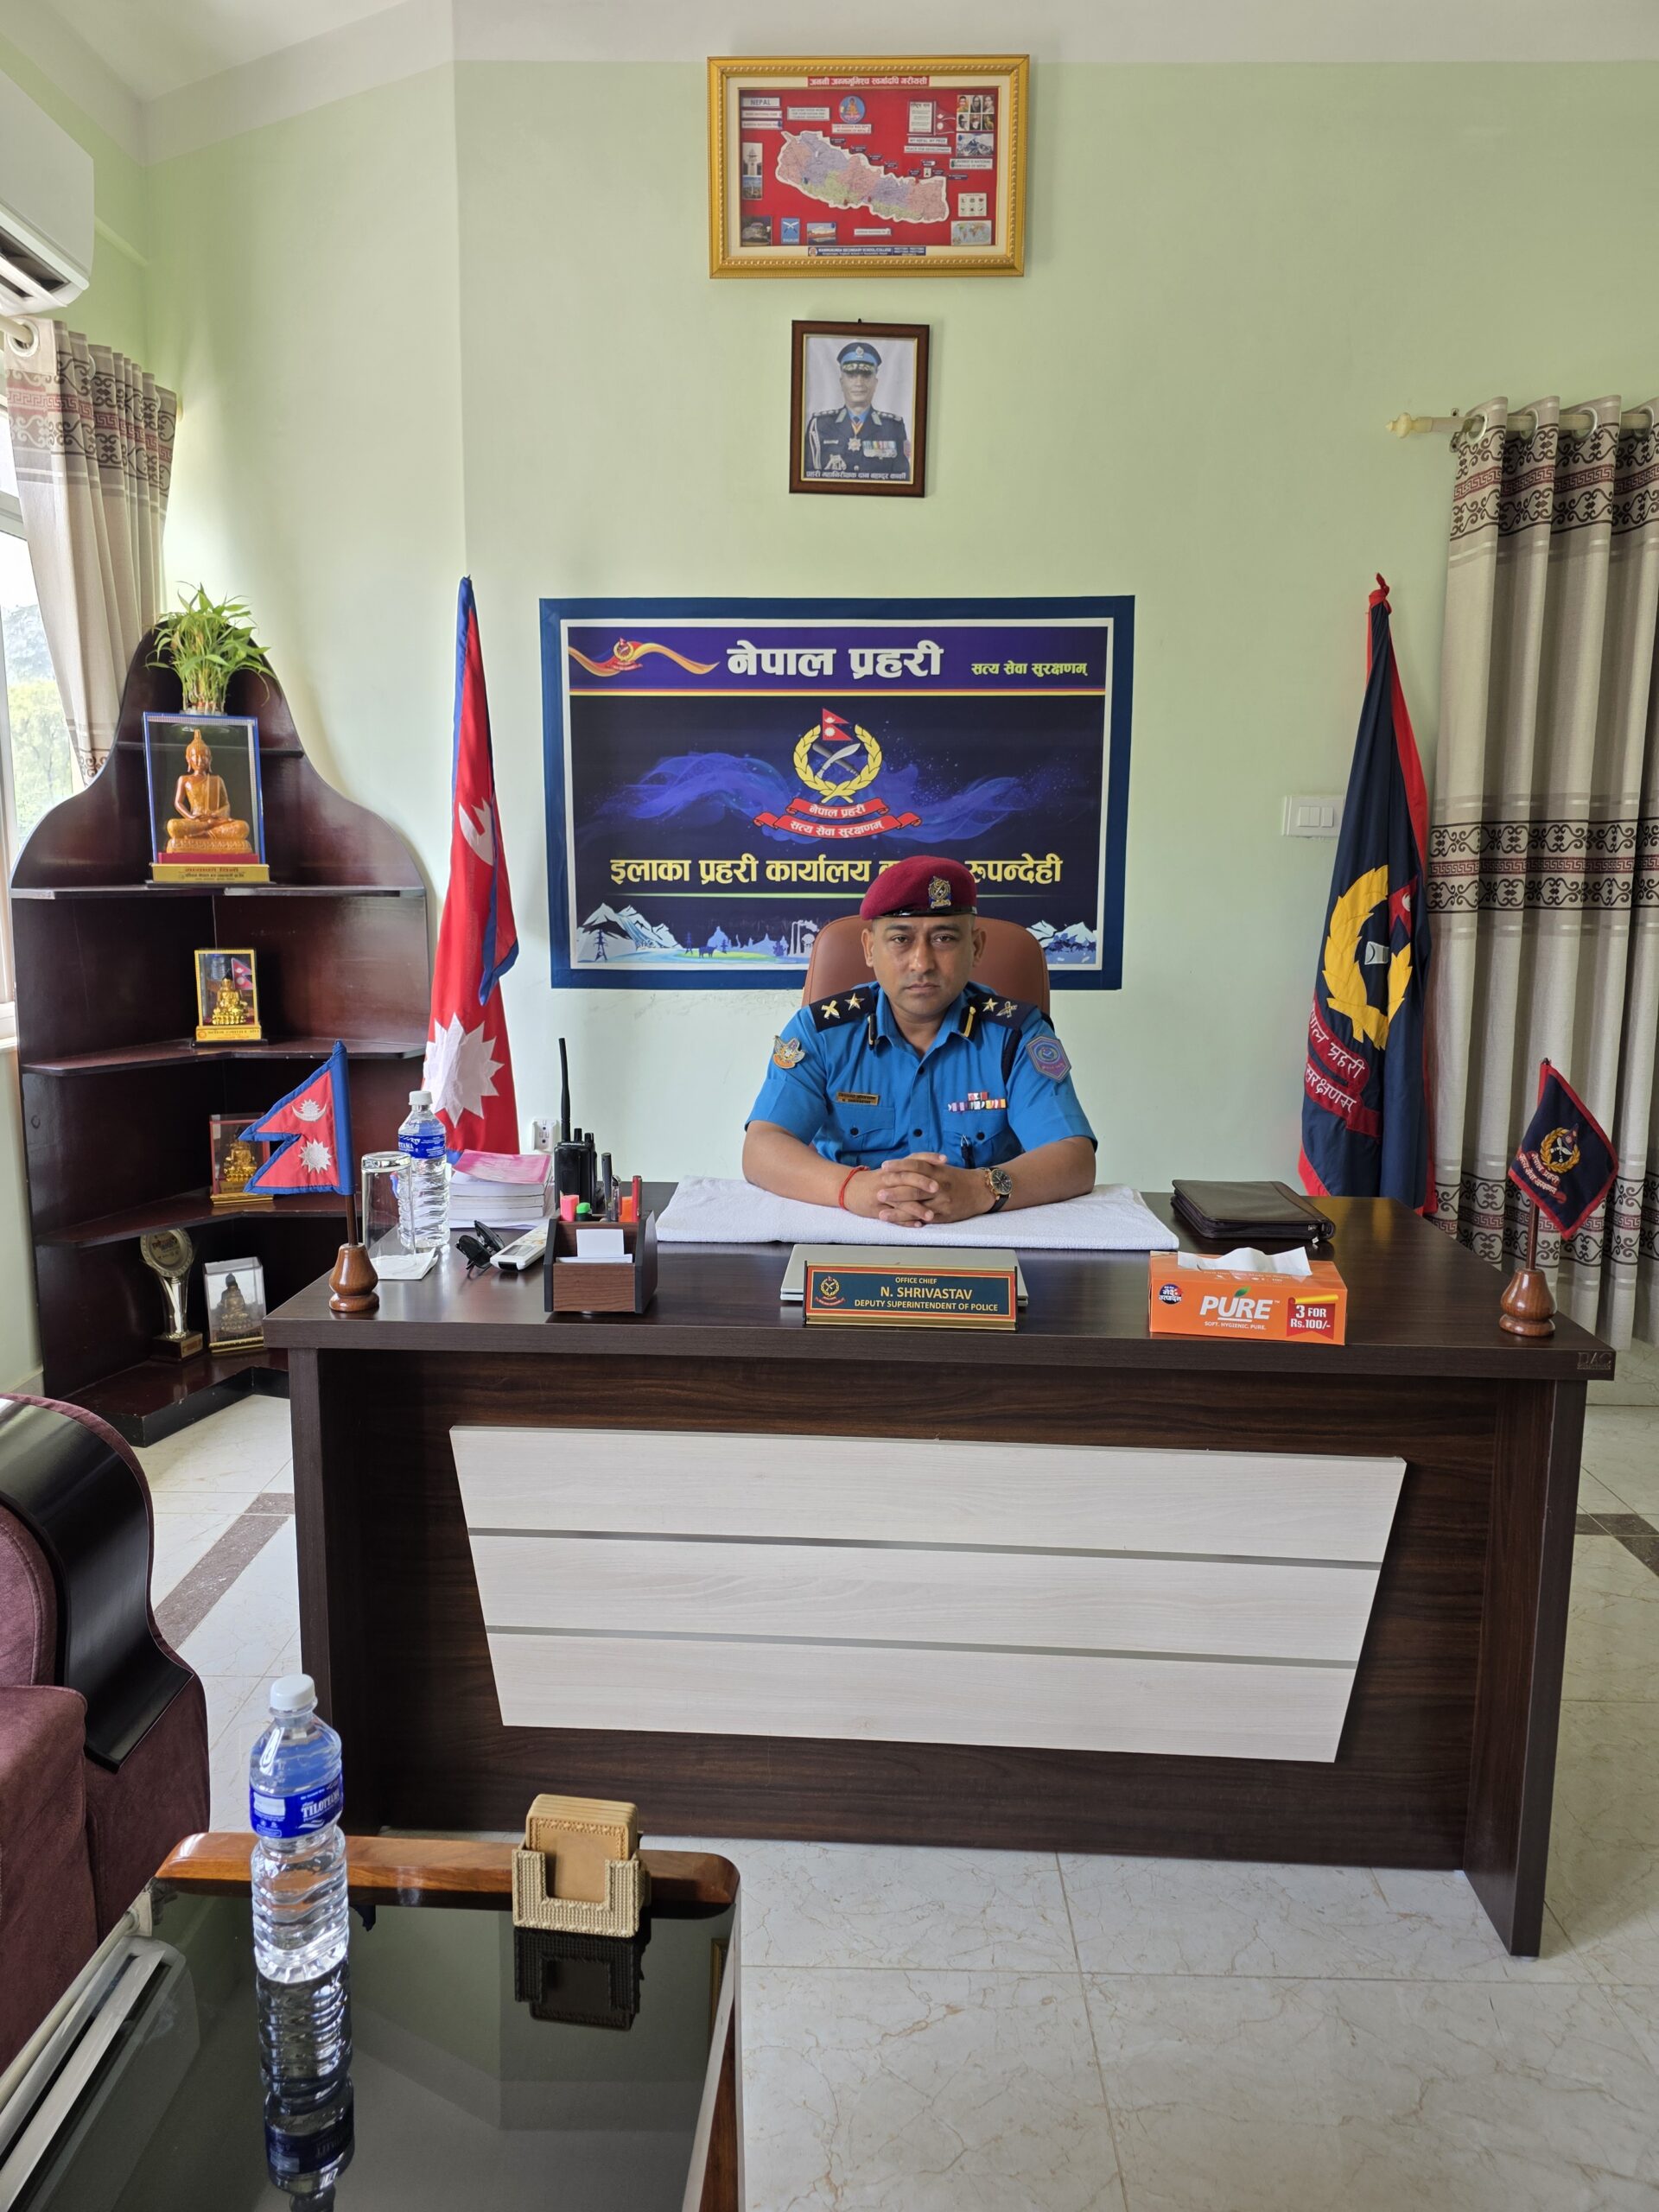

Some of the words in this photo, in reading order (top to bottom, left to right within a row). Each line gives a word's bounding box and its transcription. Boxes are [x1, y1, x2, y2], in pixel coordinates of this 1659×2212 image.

[726, 639, 836, 677] नेपाल
[848, 639, 944, 680] प्रहरी
[970, 663, 1000, 676] सत्य
[1003, 659, 1028, 676] सेवा
[1031, 662, 1089, 677] सुरक्षणम्
[809, 803, 838, 817] नेपाल
[840, 803, 866, 818] प्रहरी
[790, 820, 813, 834] सत्य
[816, 823, 835, 836] सेवा
[838, 820, 885, 838] सुरक्षणम्
[609, 859, 692, 885] इलाका
[698, 852, 759, 885] प्रहरी
[766, 854, 872, 883] कार्यालय
[880, 1287, 893, 1297] N.
[897, 1287, 973, 1300] SHRIVASTAV
[855, 1299, 886, 1307] DEPUTY
[887, 1300, 957, 1310] SUPERINTENDENT
[958, 1302, 969, 1311] OF
[970, 1302, 998, 1312] POLICE
[1199, 1295, 1274, 1319] PURE
[1295, 1305, 1305, 1319] 3
[1307, 1307, 1327, 1318] FOR
[1290, 1318, 1331, 1329] Rs.100/-
